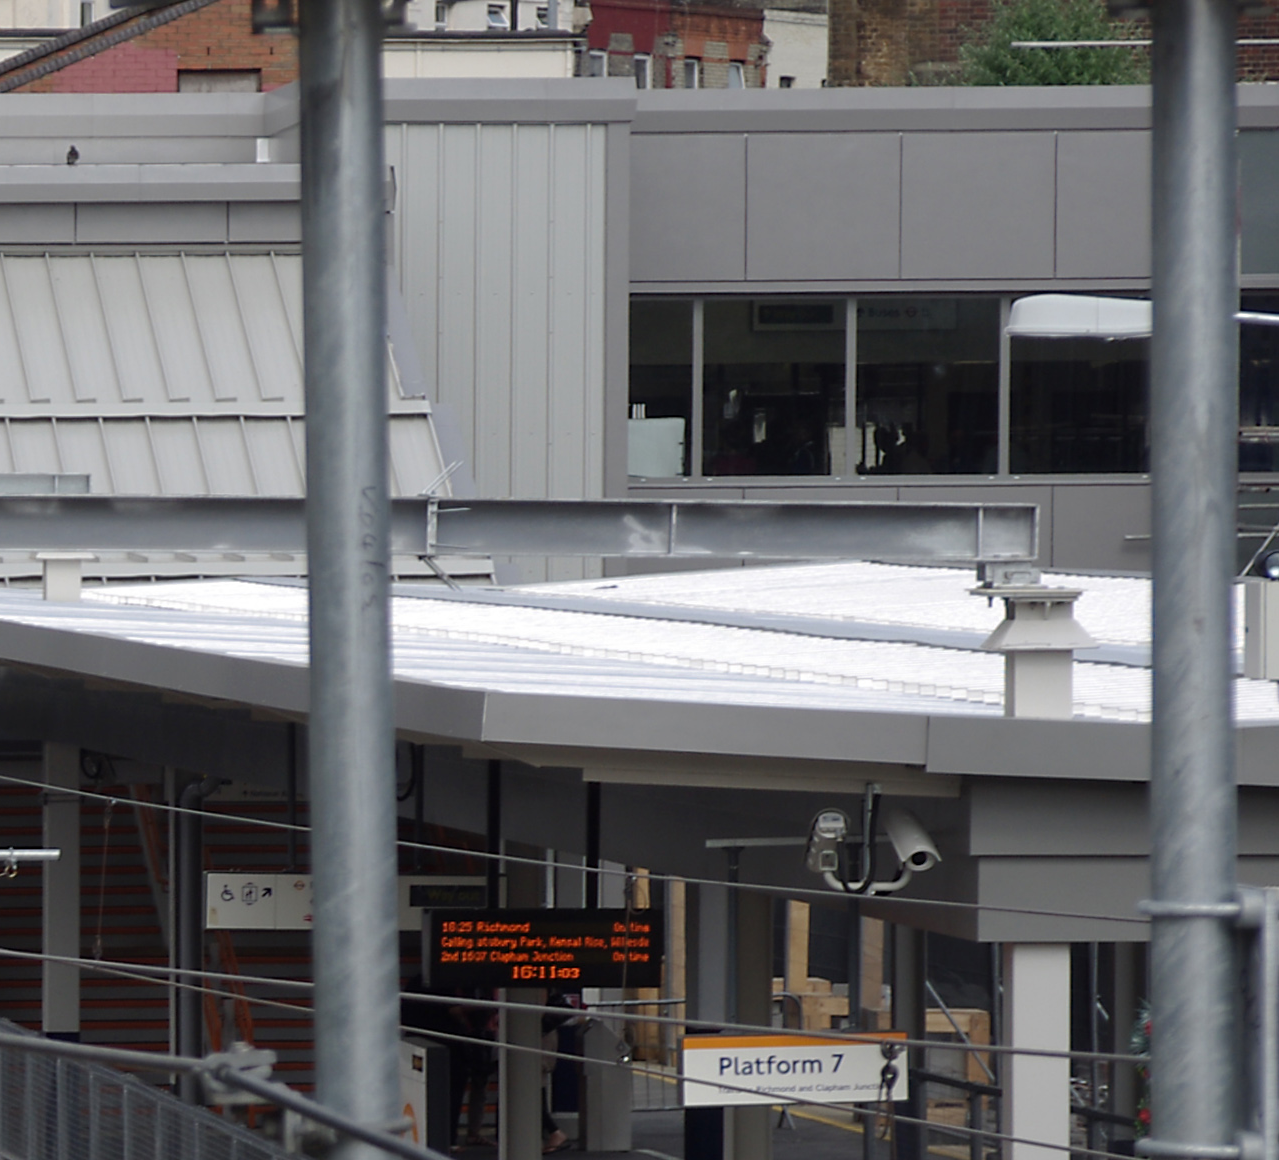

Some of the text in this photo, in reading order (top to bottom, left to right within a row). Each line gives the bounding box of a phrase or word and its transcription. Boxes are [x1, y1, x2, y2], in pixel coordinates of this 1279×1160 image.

[476, 920, 531, 933] Richmond
[511, 965, 581, 979] 16:11:03
[719, 1053, 844, 1076] Platform 7
[756, 1084, 796, 1093] Richmond
[815, 1084, 851, 1093] Clapham
